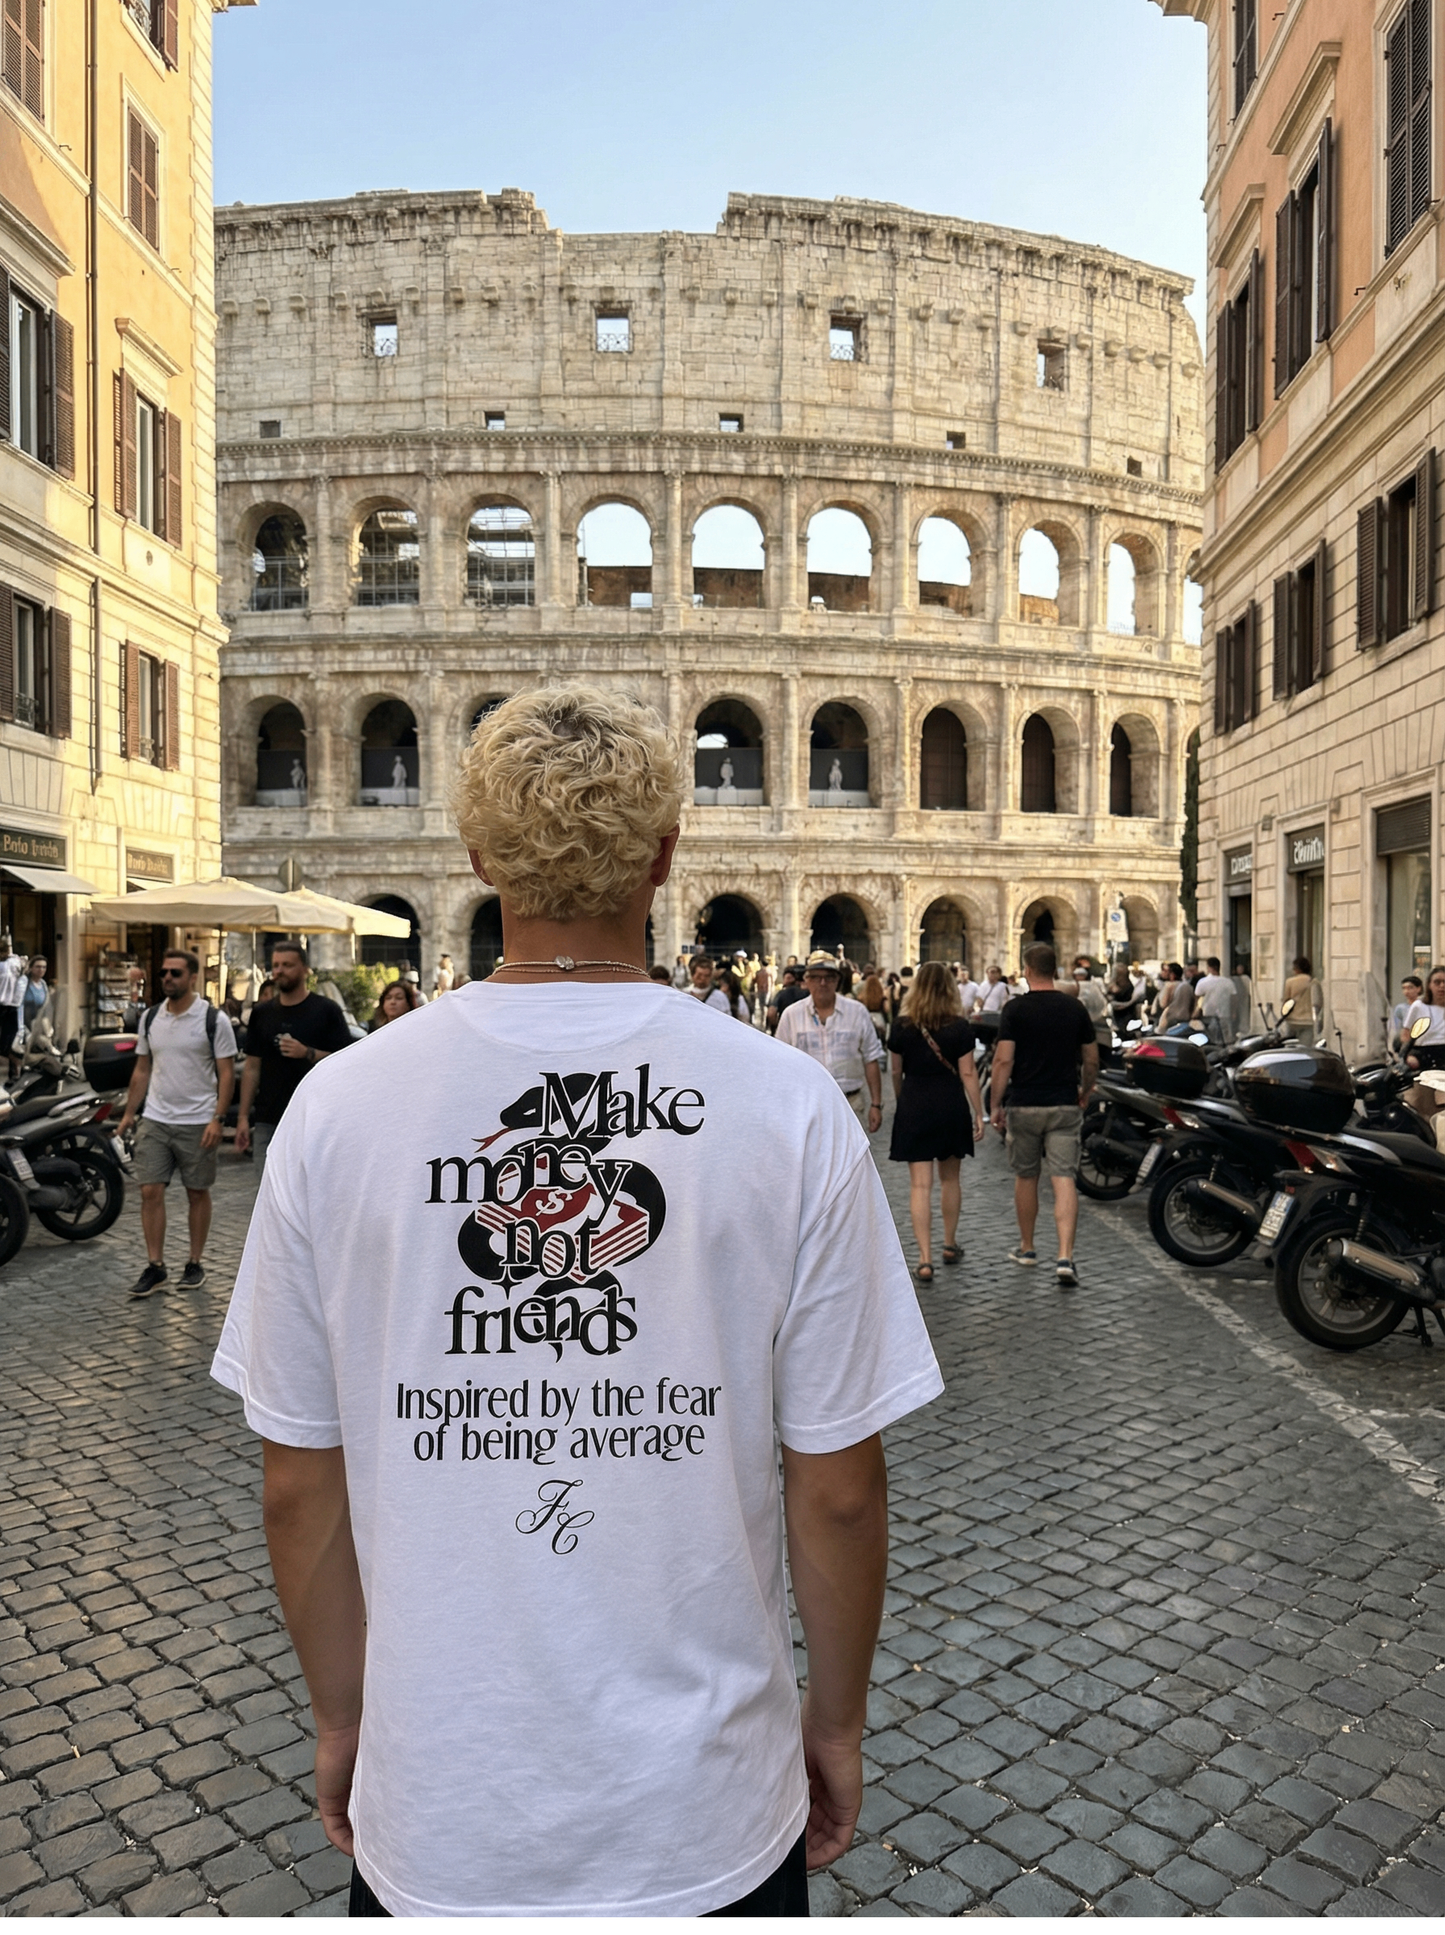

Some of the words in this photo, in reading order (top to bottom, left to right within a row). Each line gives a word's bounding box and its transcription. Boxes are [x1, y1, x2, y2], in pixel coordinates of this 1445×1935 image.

[538, 1063, 706, 1137] Make
[425, 1141, 632, 1223] money
[500, 1218, 600, 1278] not
[445, 1284, 638, 1356] friends
[397, 1379, 530, 1426] Inspired
[541, 1379, 580, 1426] by
[591, 1377, 645, 1417] the
[656, 1376, 722, 1417] fear
[413, 1422, 447, 1461] of
[461, 1421, 559, 1465] being
[569, 1423, 706, 1463] average
